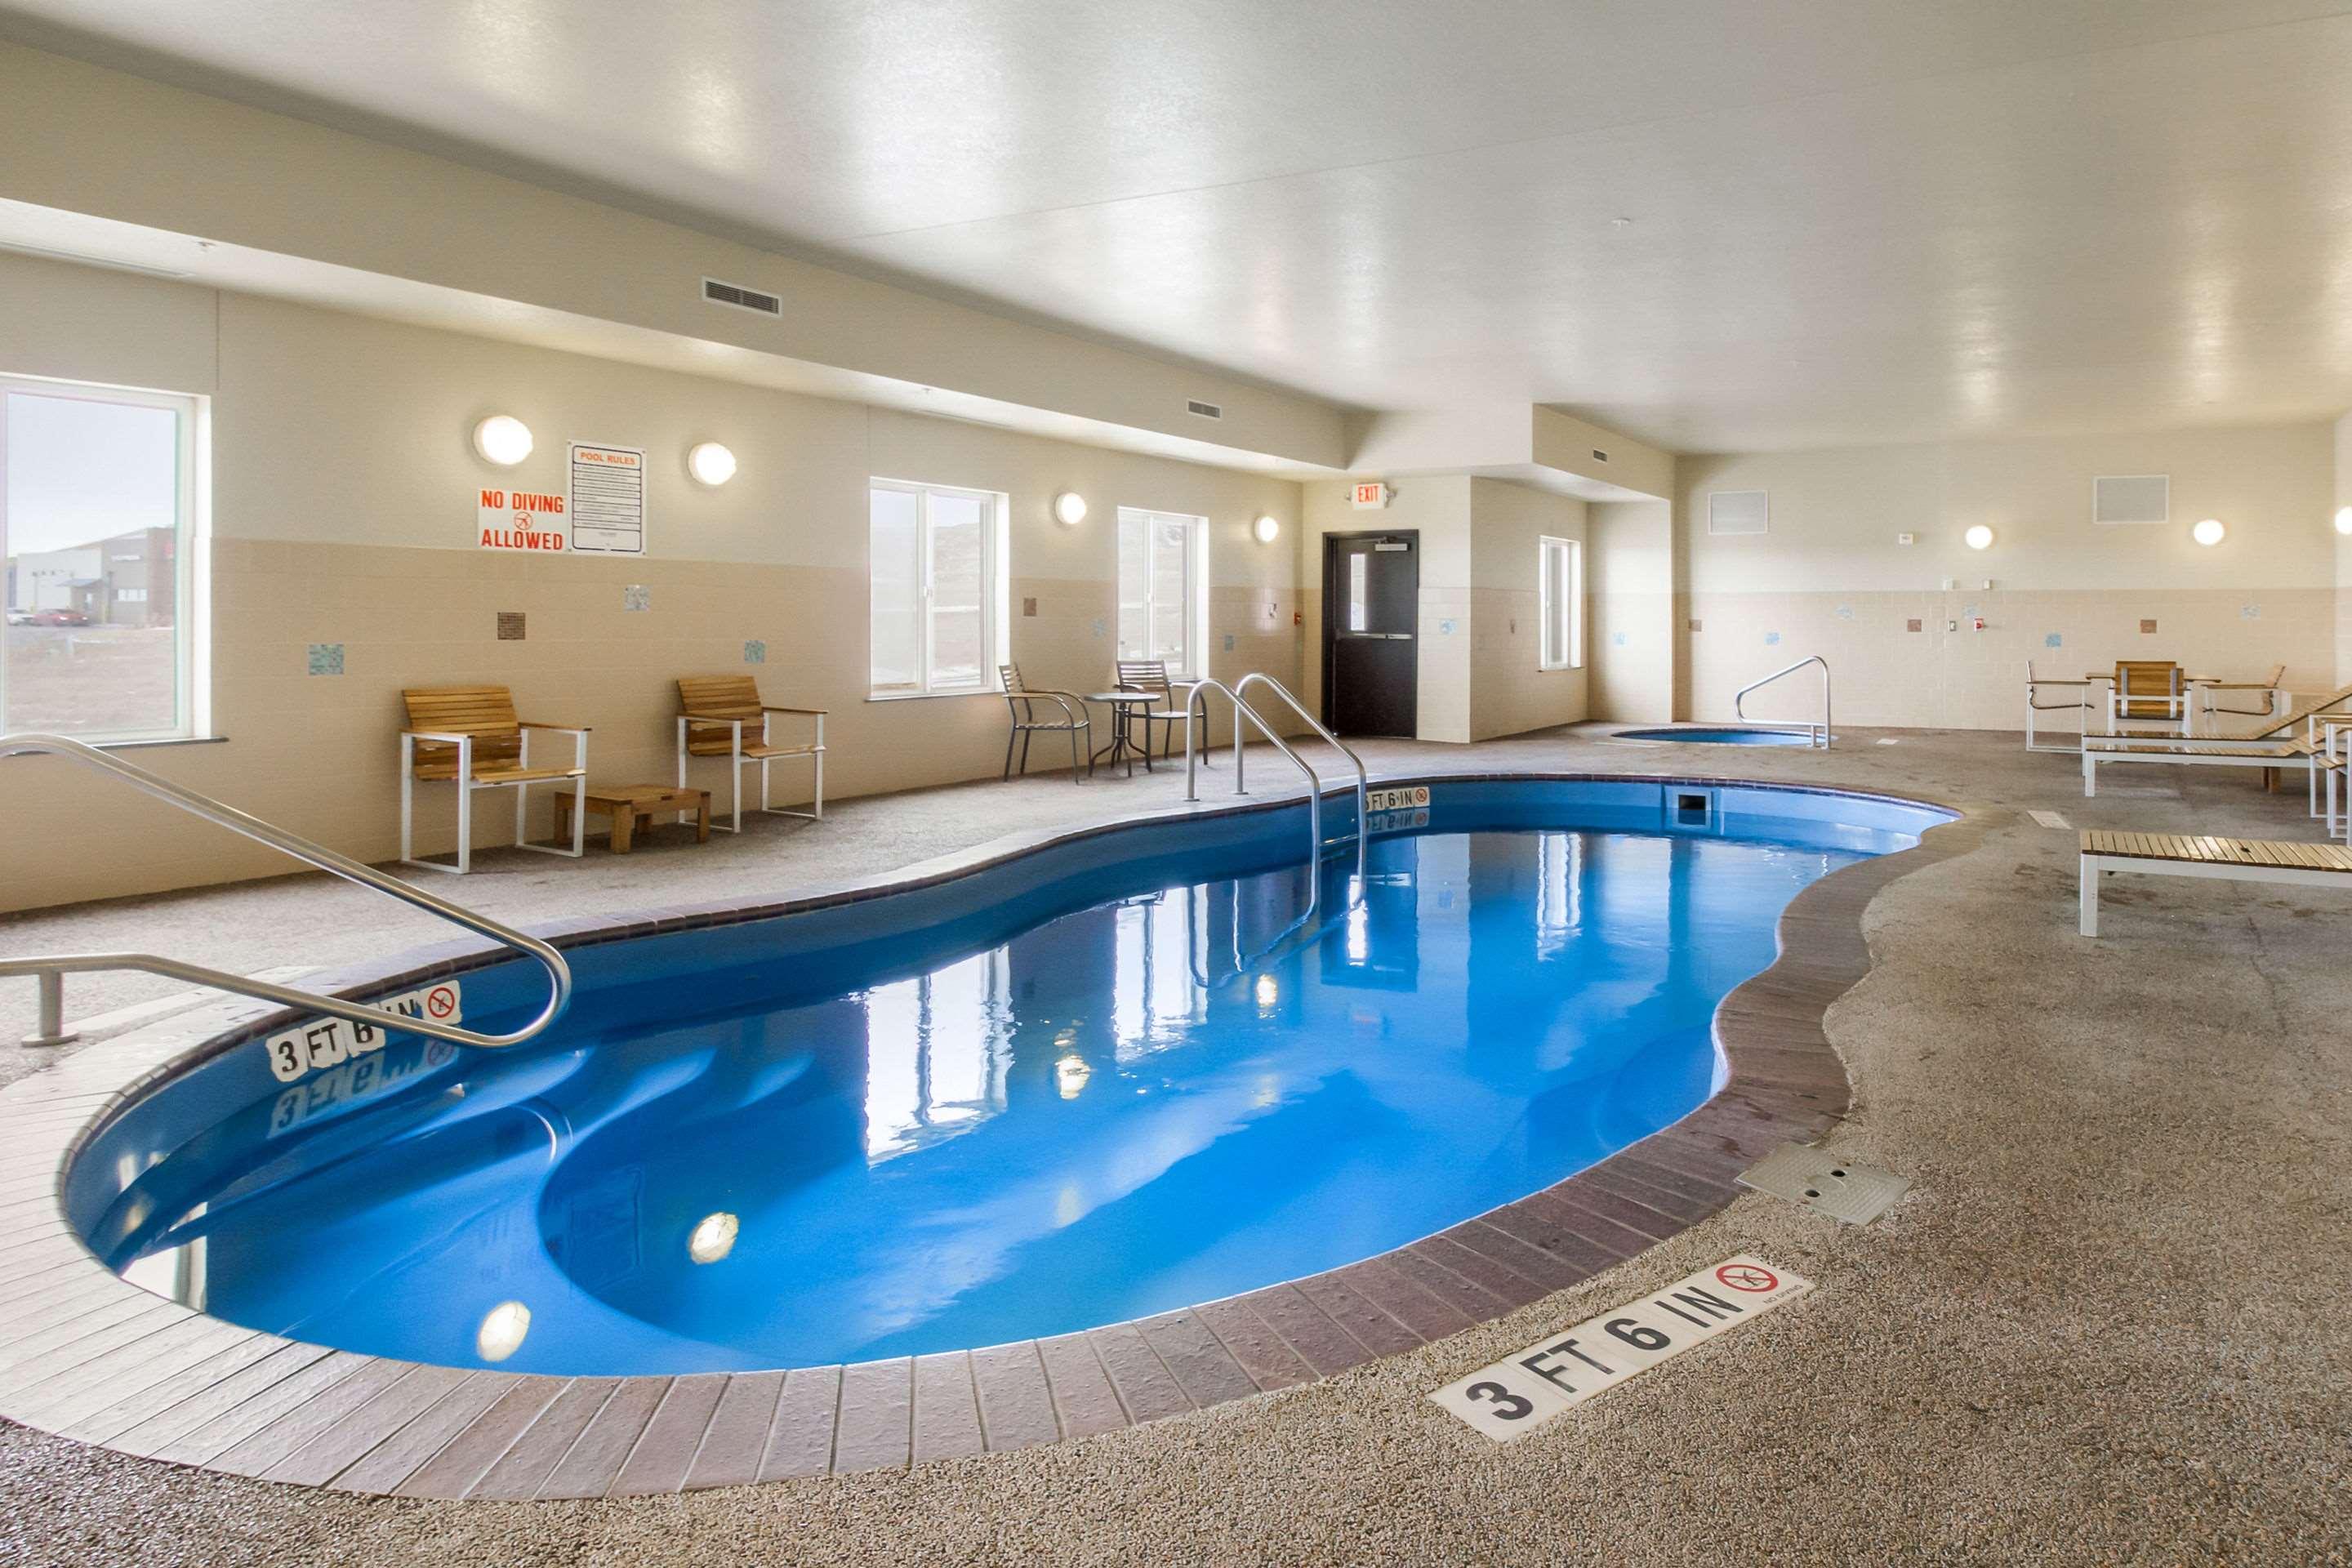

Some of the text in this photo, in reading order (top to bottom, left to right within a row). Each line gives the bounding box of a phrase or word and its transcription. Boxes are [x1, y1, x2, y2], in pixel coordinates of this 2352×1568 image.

[580, 452, 635, 466] POOL RULES
[481, 490, 504, 508] NO
[512, 492, 564, 514] DIVING
[1358, 485, 1379, 502] EXIT
[481, 529, 564, 550] ALLOWED
[1371, 793, 1383, 809] FT
[1388, 792, 1396, 807] 6
[1400, 790, 1413, 806] IN
[278, 1040, 298, 1072] 3
[306, 1022, 337, 1060] FT
[1465, 1286, 1744, 1420] 3 FT 6 IN
